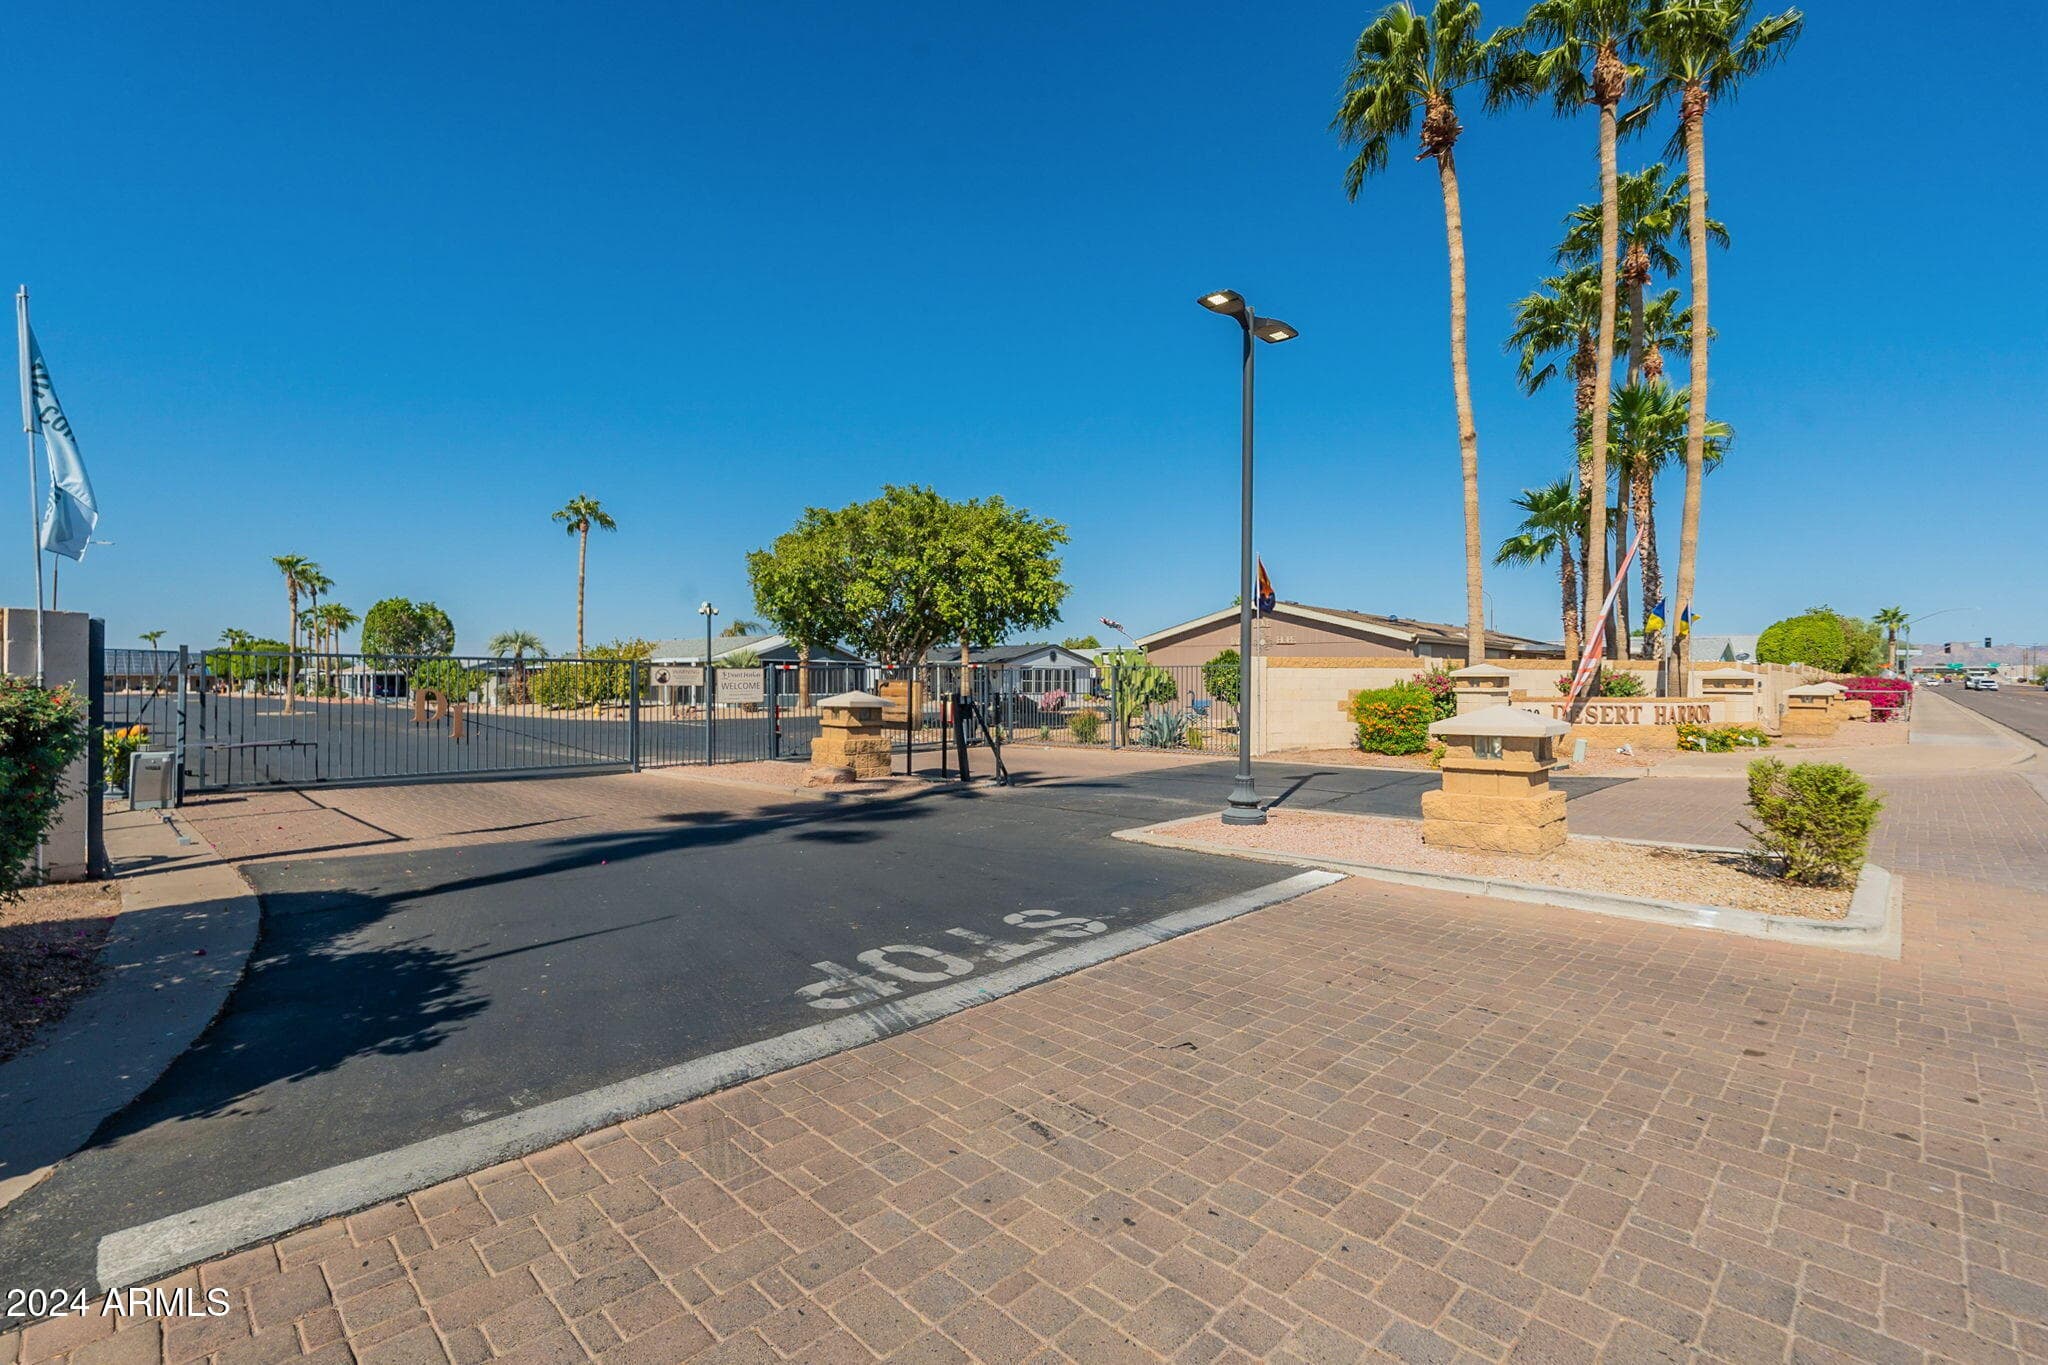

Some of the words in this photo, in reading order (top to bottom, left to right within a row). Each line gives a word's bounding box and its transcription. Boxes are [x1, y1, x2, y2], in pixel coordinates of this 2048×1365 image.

[721, 682, 761, 690] WELCOME
[1551, 703, 1643, 725] DESERT
[1654, 704, 1711, 725] HARBOR
[795, 909, 1108, 1010] STOP
